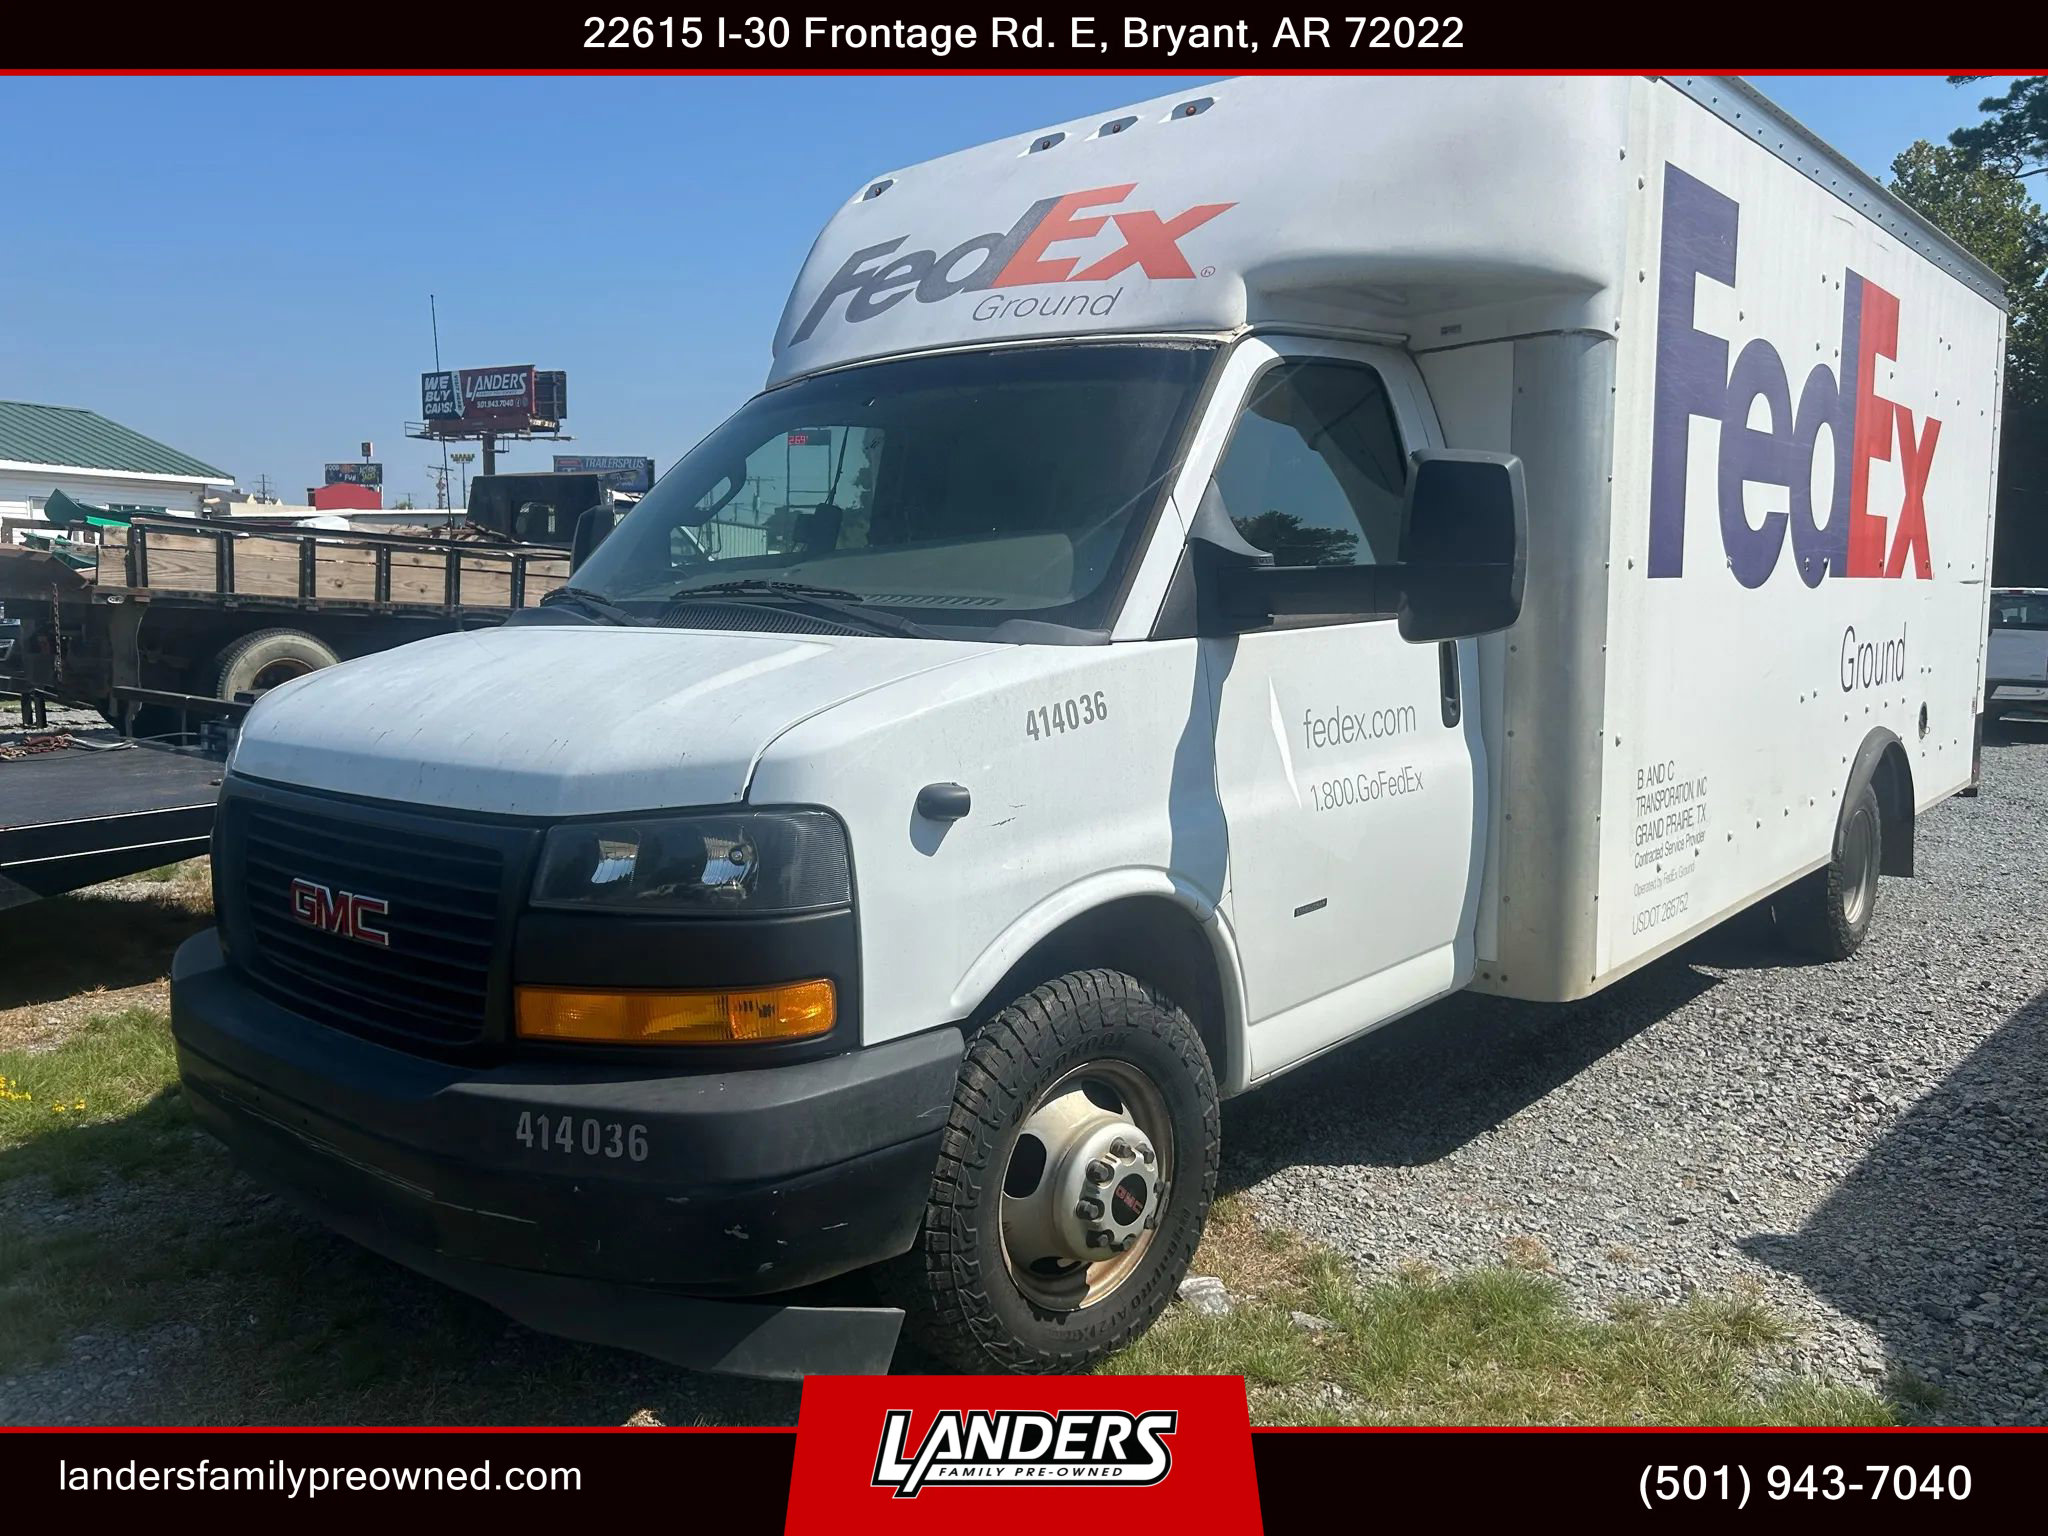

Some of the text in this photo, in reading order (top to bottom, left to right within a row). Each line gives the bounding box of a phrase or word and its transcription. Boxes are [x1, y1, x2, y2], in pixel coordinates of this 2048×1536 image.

[788, 182, 1238, 348] FedEx
[972, 287, 1123, 322] Ground
[424, 375, 449, 391] WE
[424, 390, 452, 402] BUY
[466, 372, 527, 402] LANDERS
[1648, 160, 1942, 590] FedEx
[1840, 622, 1906, 693] Ground
[1025, 690, 1108, 742] 414036
[1303, 704, 1416, 749] fedex.com
[1310, 765, 1424, 812] 1.800.GoFedEx
[1637, 760, 1675, 790] B AND C
[1696, 776, 1708, 798] INC
[1635, 817, 1664, 847] GRAND
[1697, 802, 1707, 824] TX
[1634, 841, 1664, 869] Contracted
[1664, 838, 1685, 857] Service
[290, 877, 389, 946] GMC
[1632, 904, 1661, 935] USDOT
[516, 1111, 649, 1162] 414036
